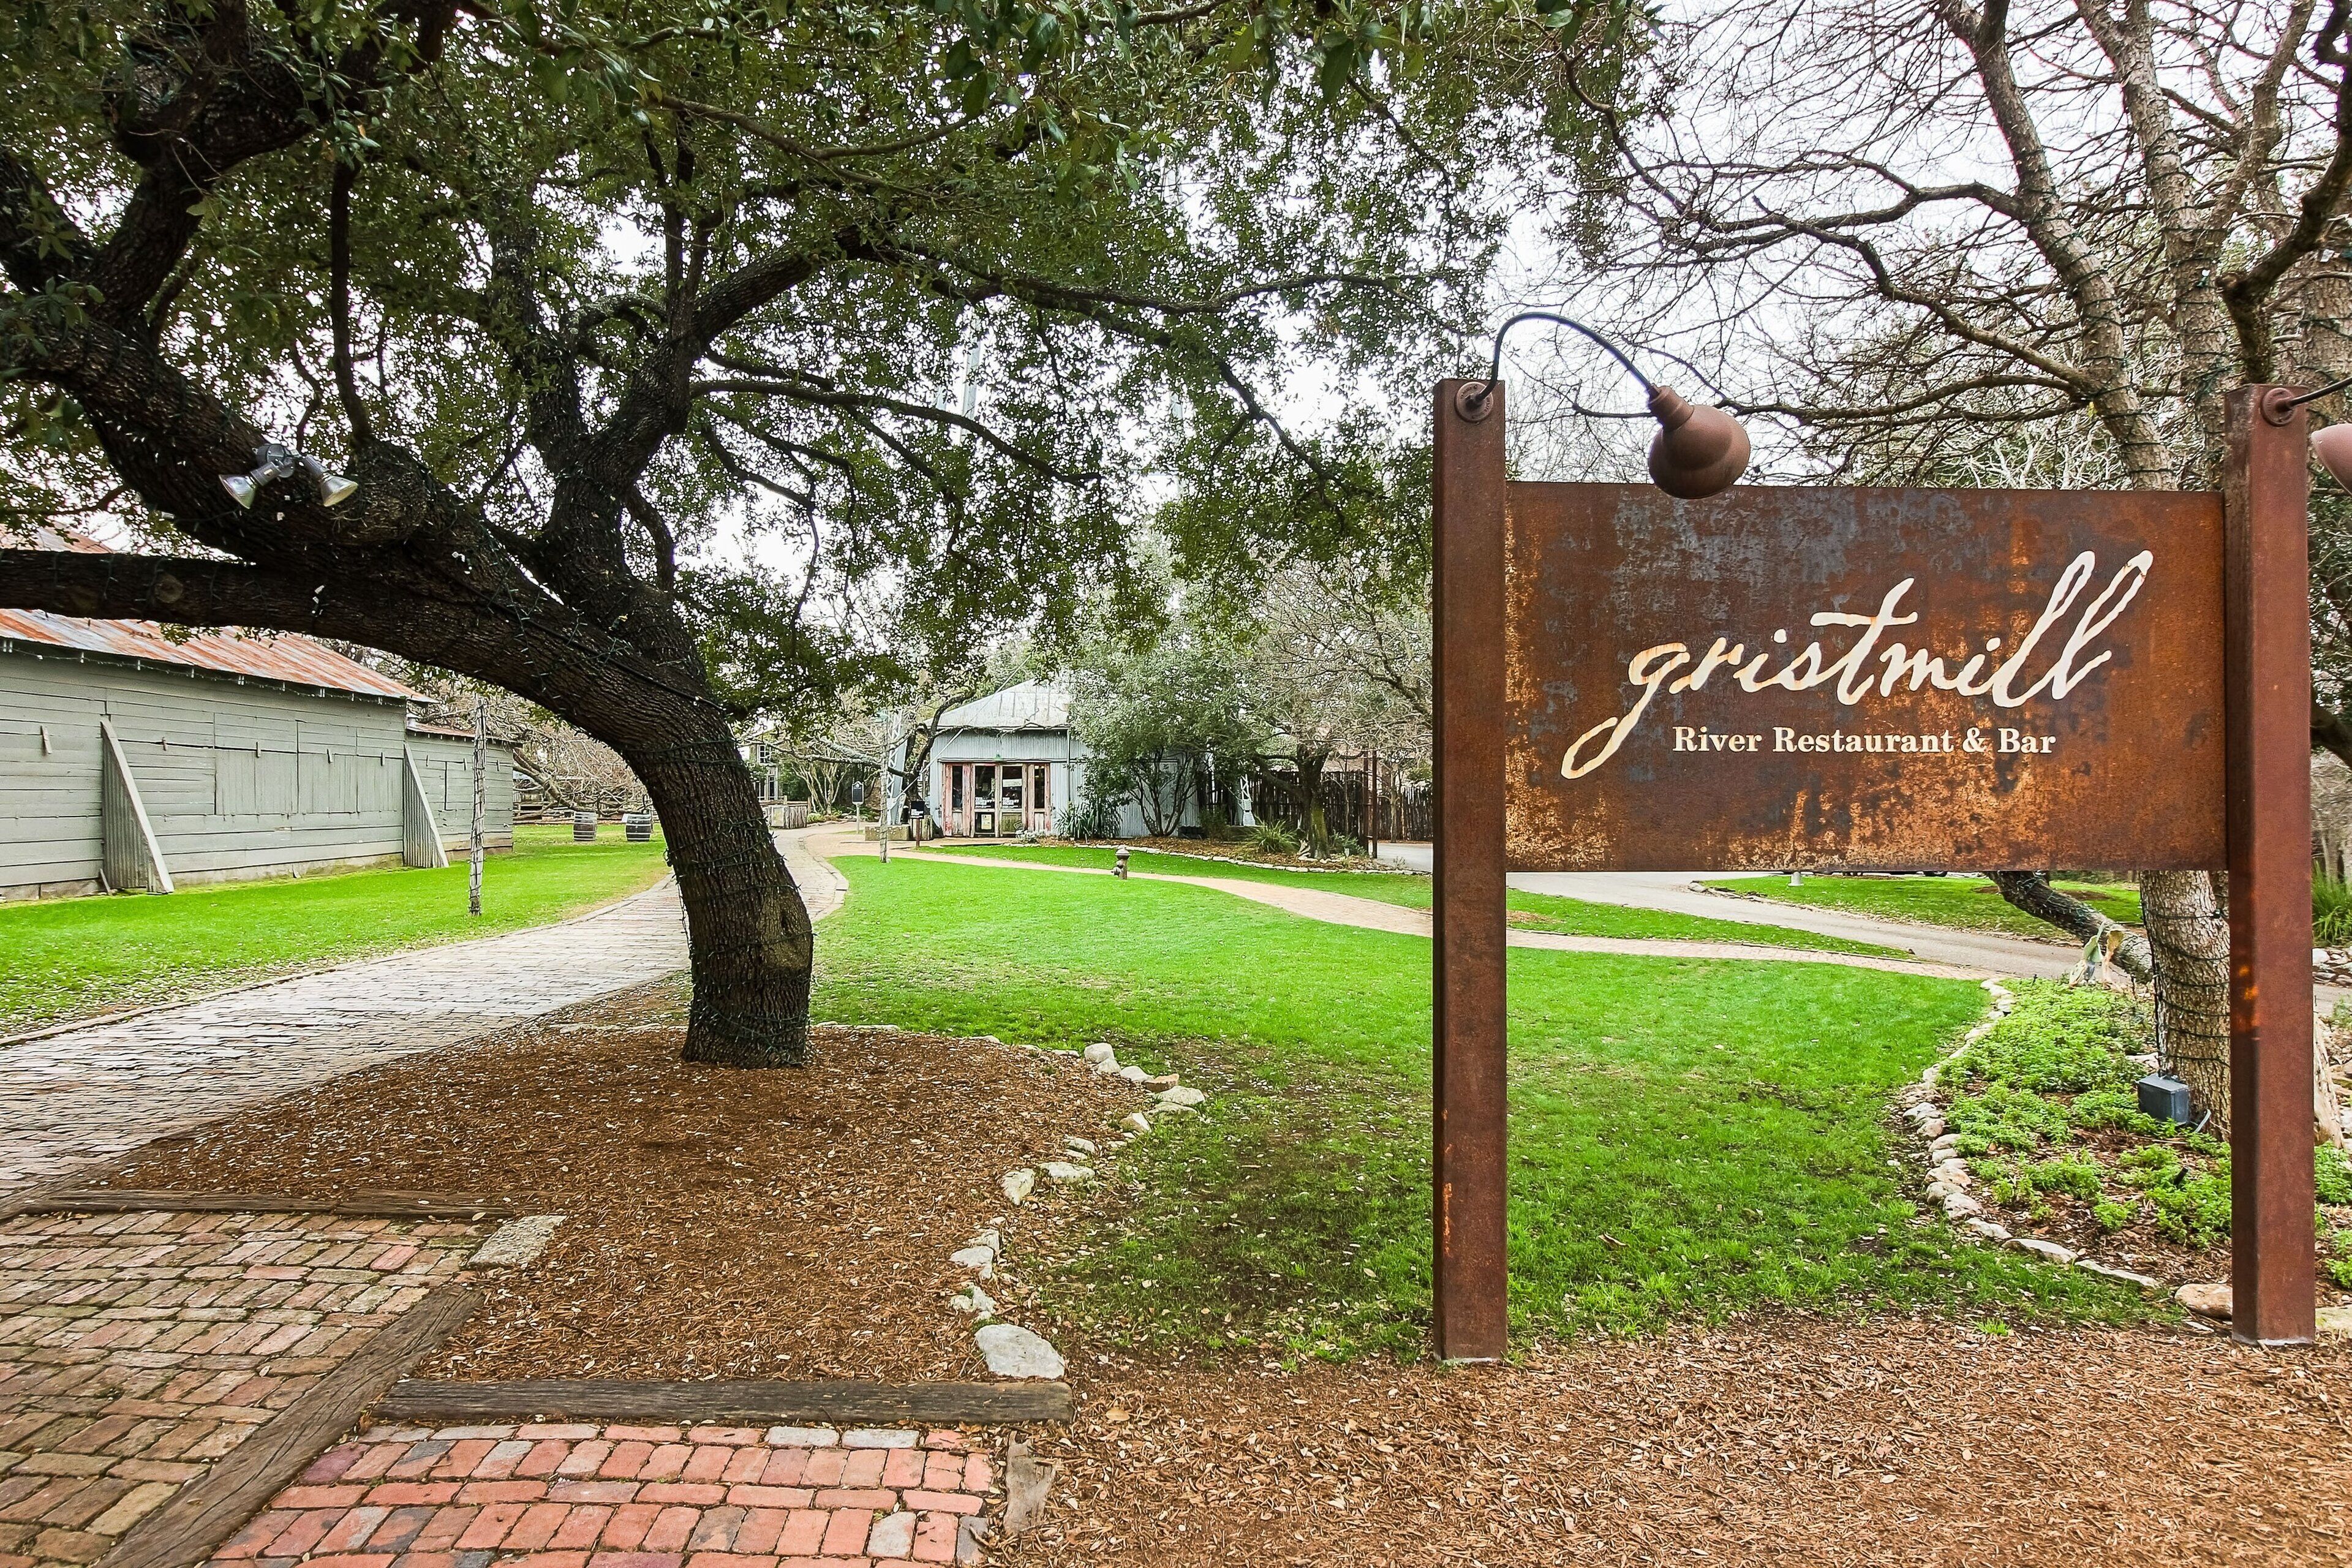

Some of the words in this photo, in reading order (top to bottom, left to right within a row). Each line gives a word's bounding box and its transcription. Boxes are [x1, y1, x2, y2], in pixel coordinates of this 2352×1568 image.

[1561, 550, 2154, 779] gristmill
[1672, 726, 1763, 753] River
[1772, 726, 1955, 753] Restaurant
[1962, 728, 1993, 753] &
[1997, 728, 2057, 753] Bar
